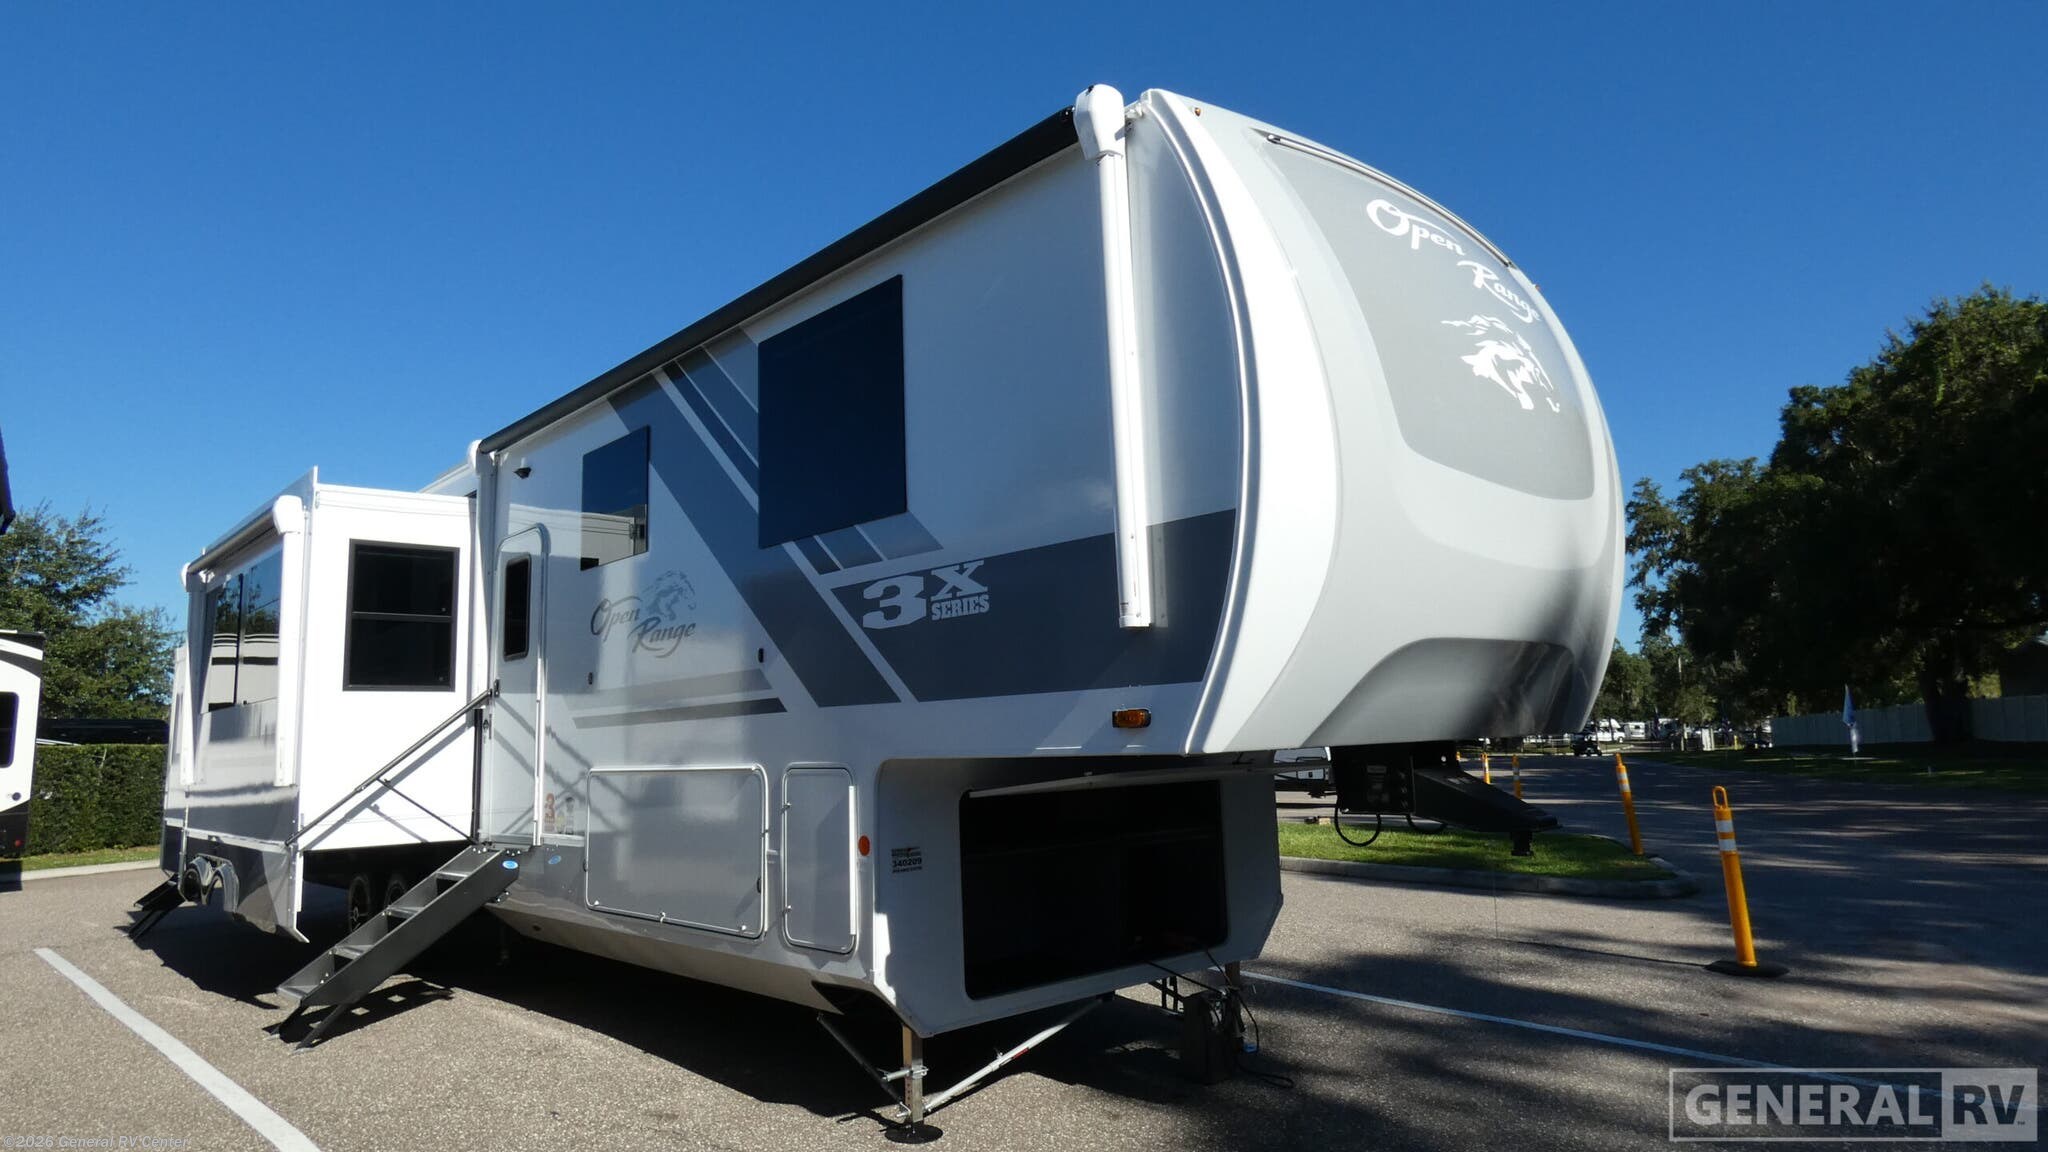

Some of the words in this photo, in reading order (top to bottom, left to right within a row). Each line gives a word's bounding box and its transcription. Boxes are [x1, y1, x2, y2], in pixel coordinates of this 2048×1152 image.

[1366, 199, 1465, 256] Open
[1456, 260, 1542, 324] Range
[590, 598, 643, 642] Open
[931, 593, 990, 621] SERIES
[627, 616, 697, 659] Range
